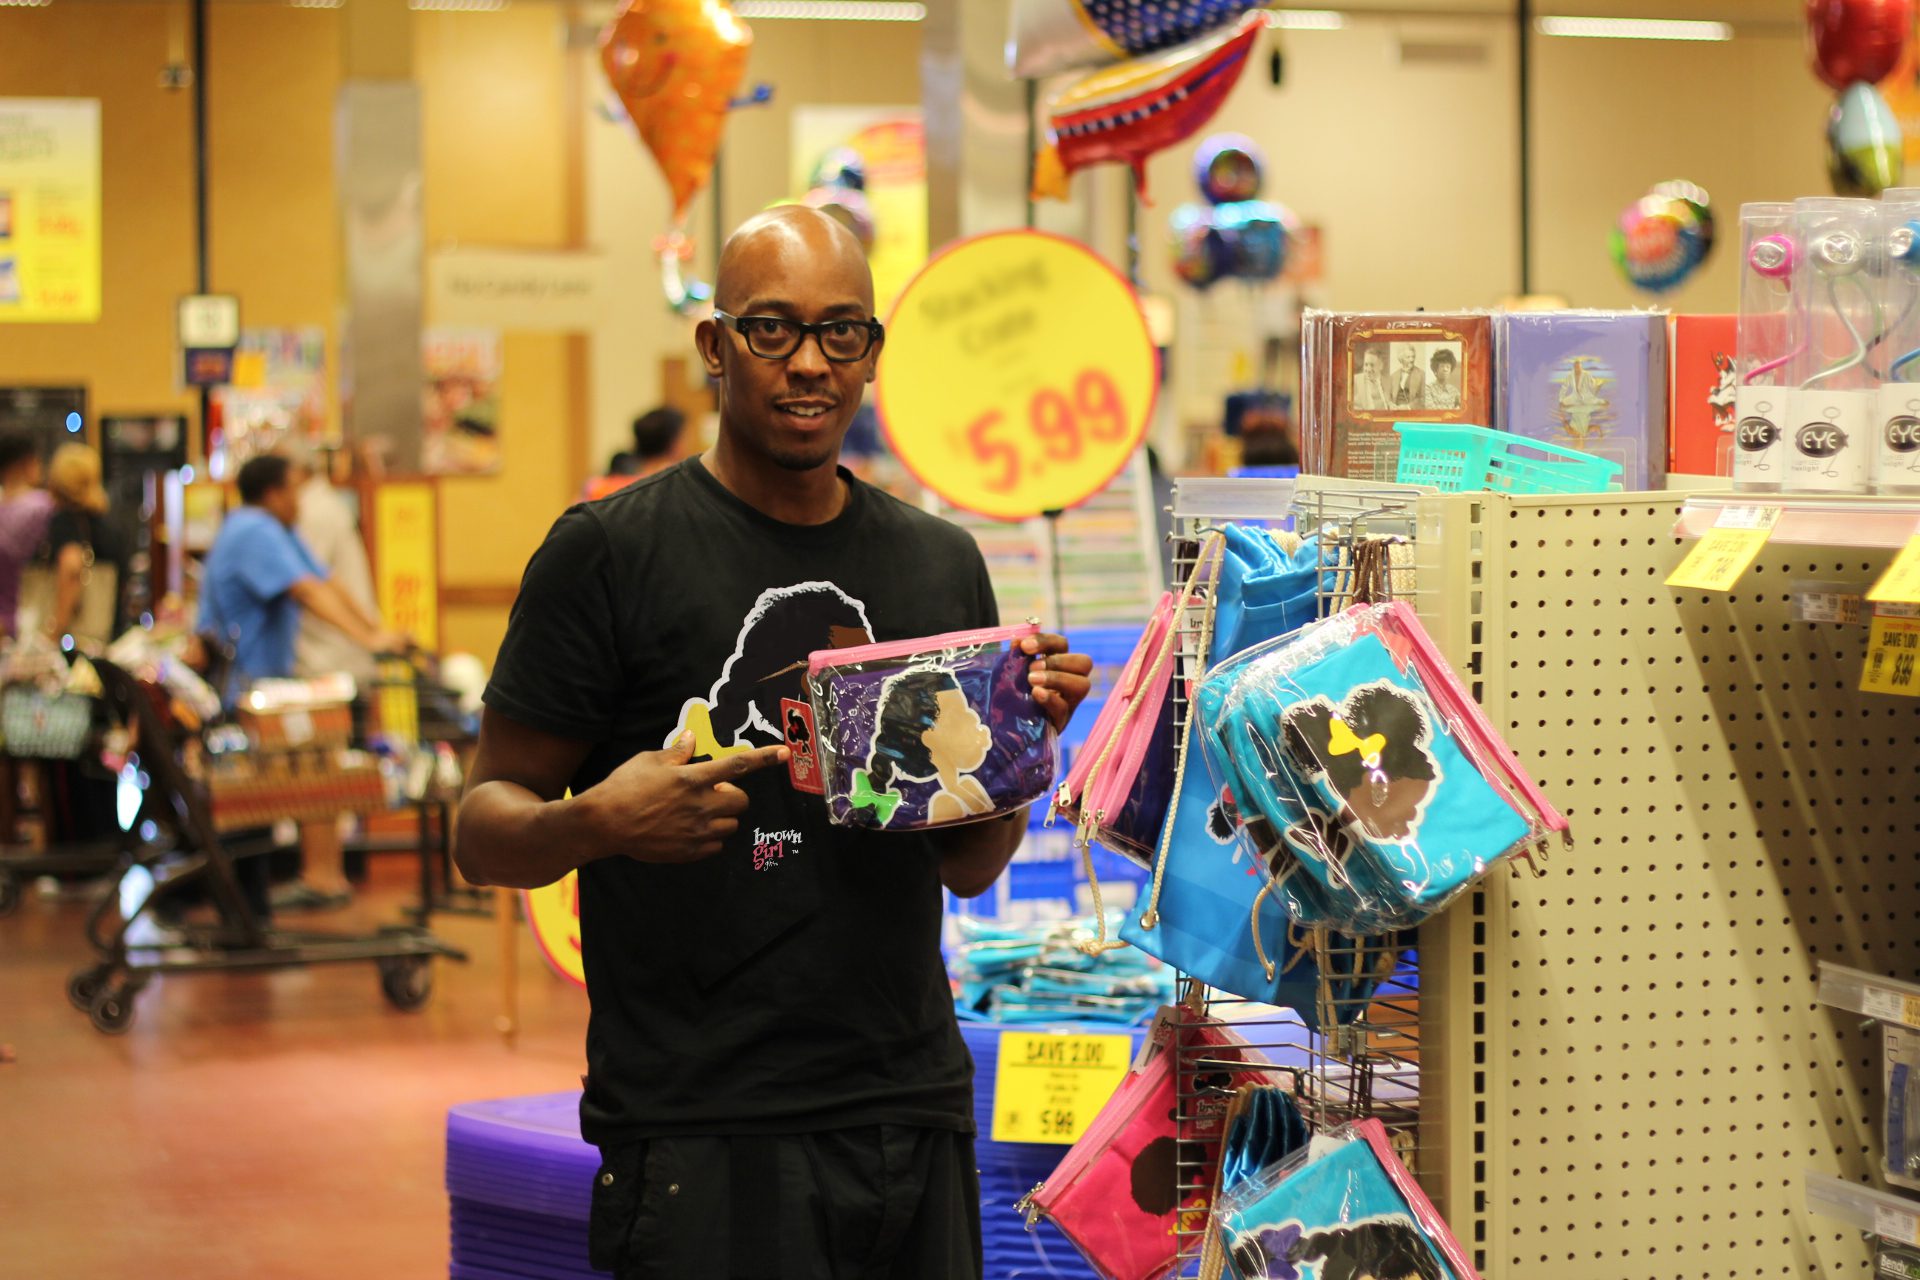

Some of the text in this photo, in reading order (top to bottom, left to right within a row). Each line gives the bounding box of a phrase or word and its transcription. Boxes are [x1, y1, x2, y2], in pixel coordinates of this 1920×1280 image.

[1740, 425, 1769, 443] EYE
[1802, 431, 1837, 449] EYE
[1888, 424, 1920, 443] EYE
[1882, 631, 1903, 648] SAVE
[753, 827, 803, 846] brown
[753, 840, 784, 870] girl
[1026, 1040, 1104, 1063] SAVE 2.00
[1880, 1253, 1908, 1276] Bendy
